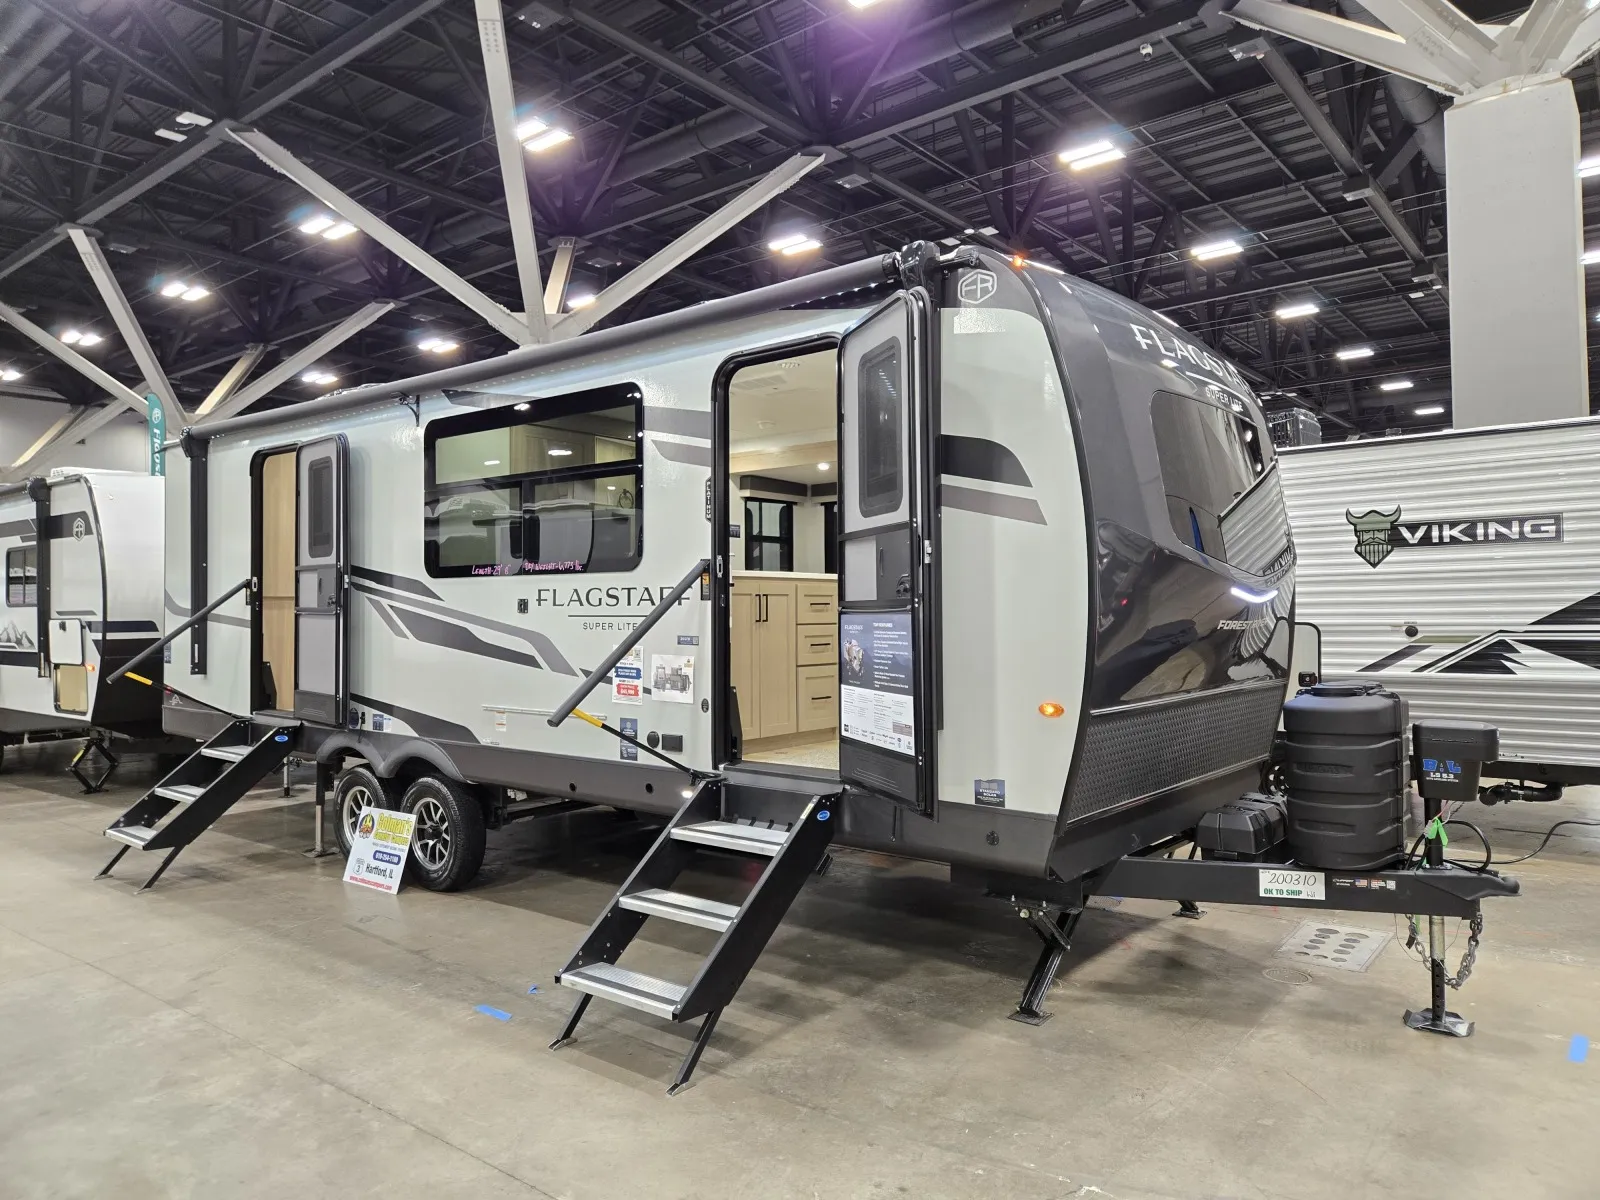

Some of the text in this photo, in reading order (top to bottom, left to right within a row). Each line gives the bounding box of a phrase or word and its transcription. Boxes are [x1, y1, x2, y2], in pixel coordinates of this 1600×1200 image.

[1206, 386, 1229, 404] SUPER
[1397, 518, 1556, 544] VIKING
[582, 622, 638, 631] SUPER LITE
[1217, 619, 1252, 629] FOREST
[365, 864, 387, 879] Hartford,
[1268, 872, 1317, 886] 200310
[1285, 889, 1303, 897] SHIP
